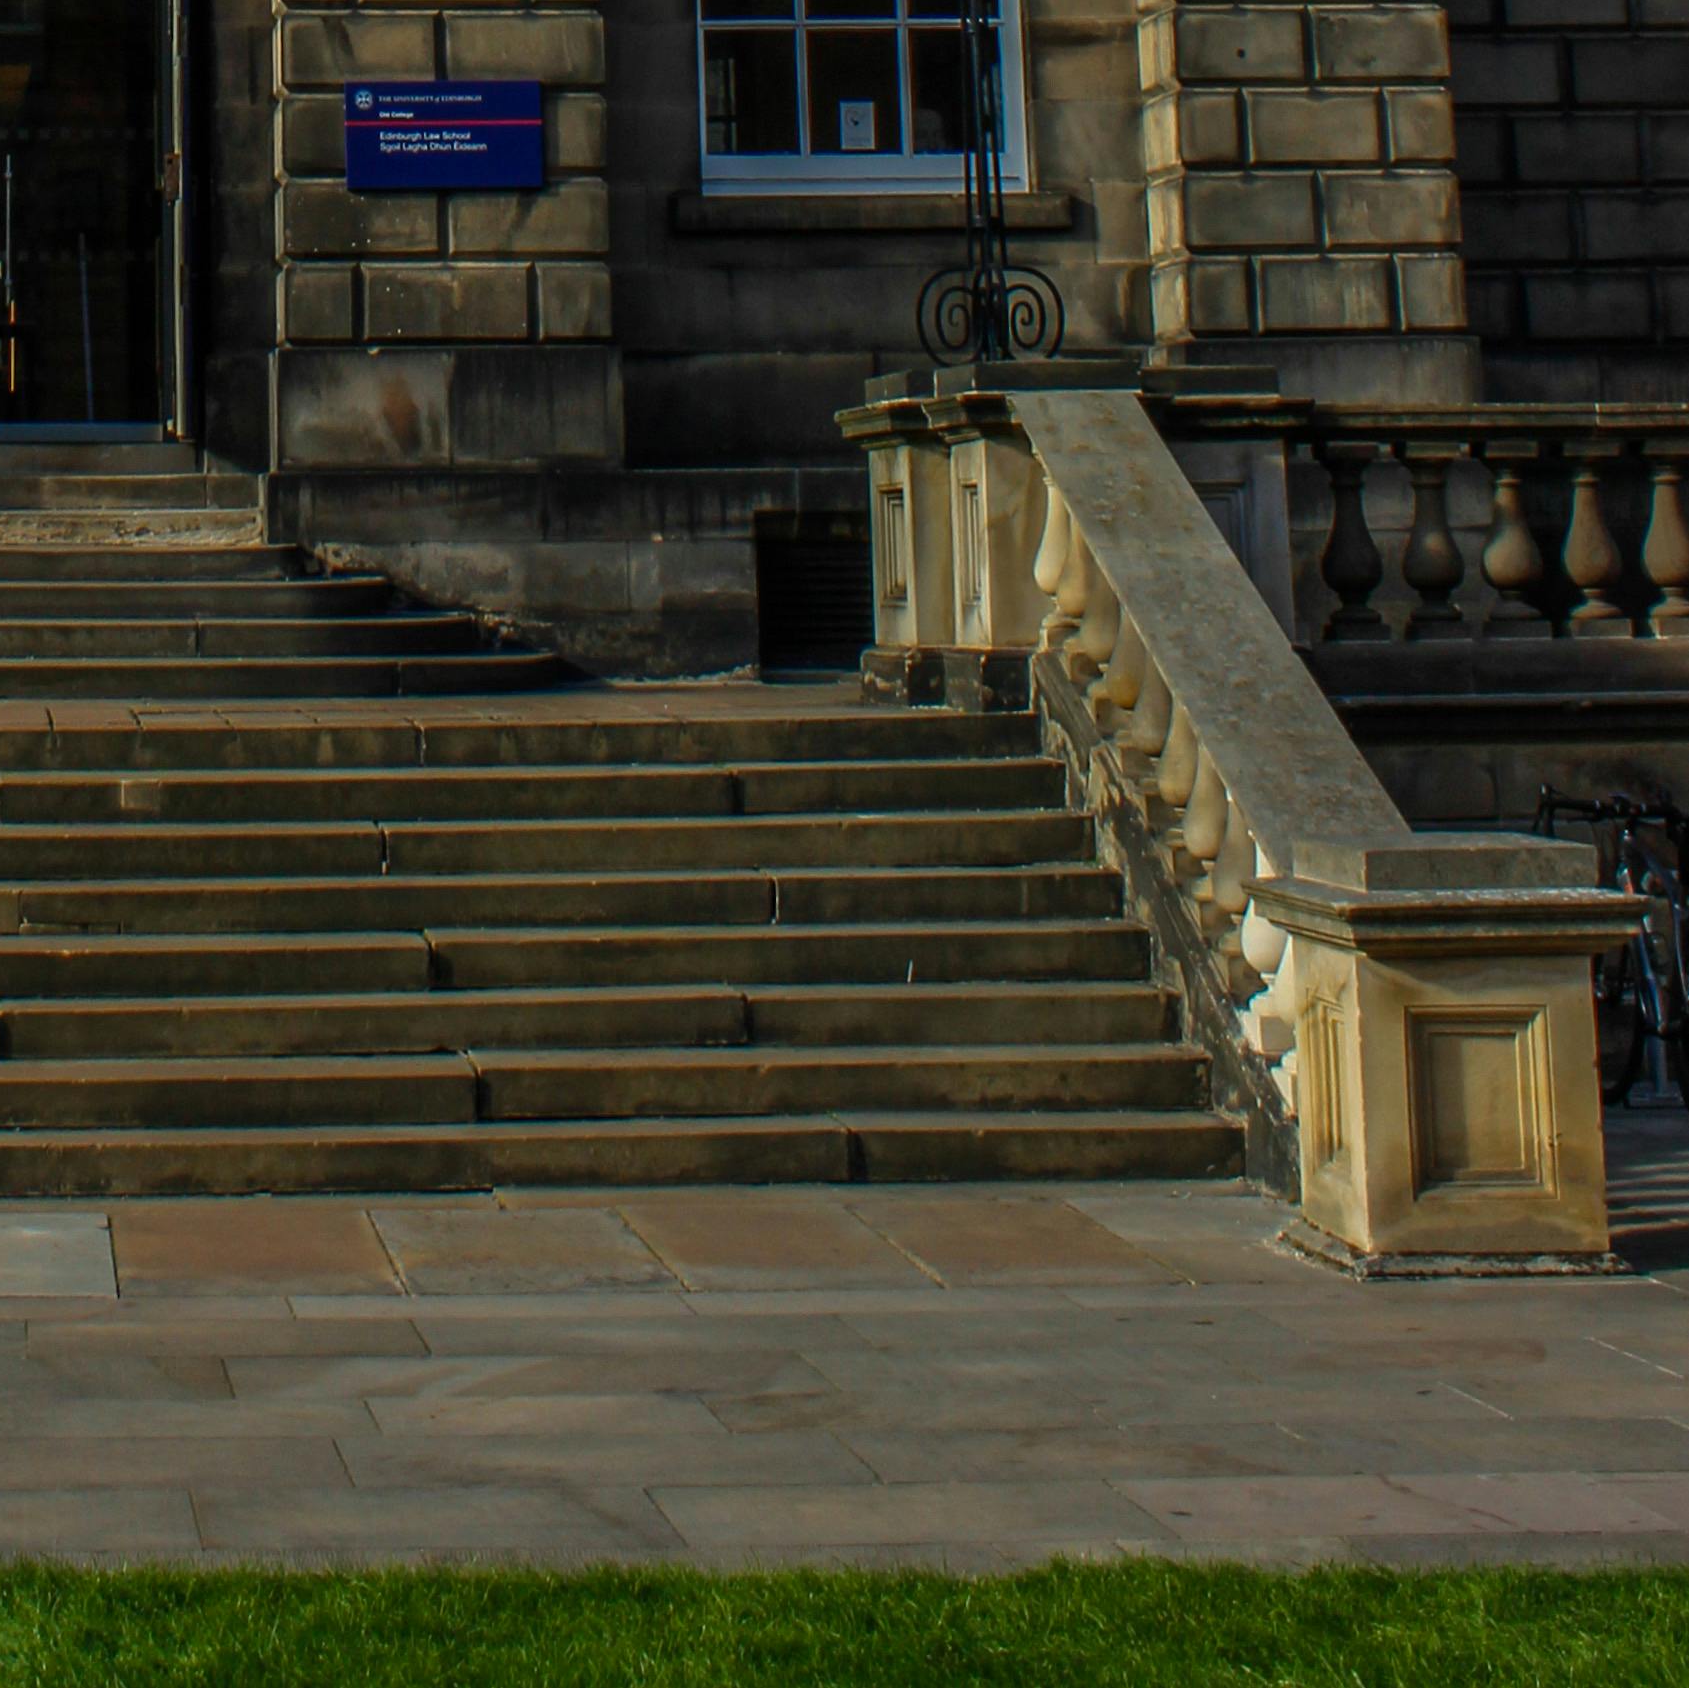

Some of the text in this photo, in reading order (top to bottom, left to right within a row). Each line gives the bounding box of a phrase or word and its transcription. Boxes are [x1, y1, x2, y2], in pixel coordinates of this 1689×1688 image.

[391, 111, 414, 119] College
[380, 131, 471, 142] Edinburgh Law School
[380, 141, 401, 153] Sgoil
[403, 142, 428, 153] Lagha
